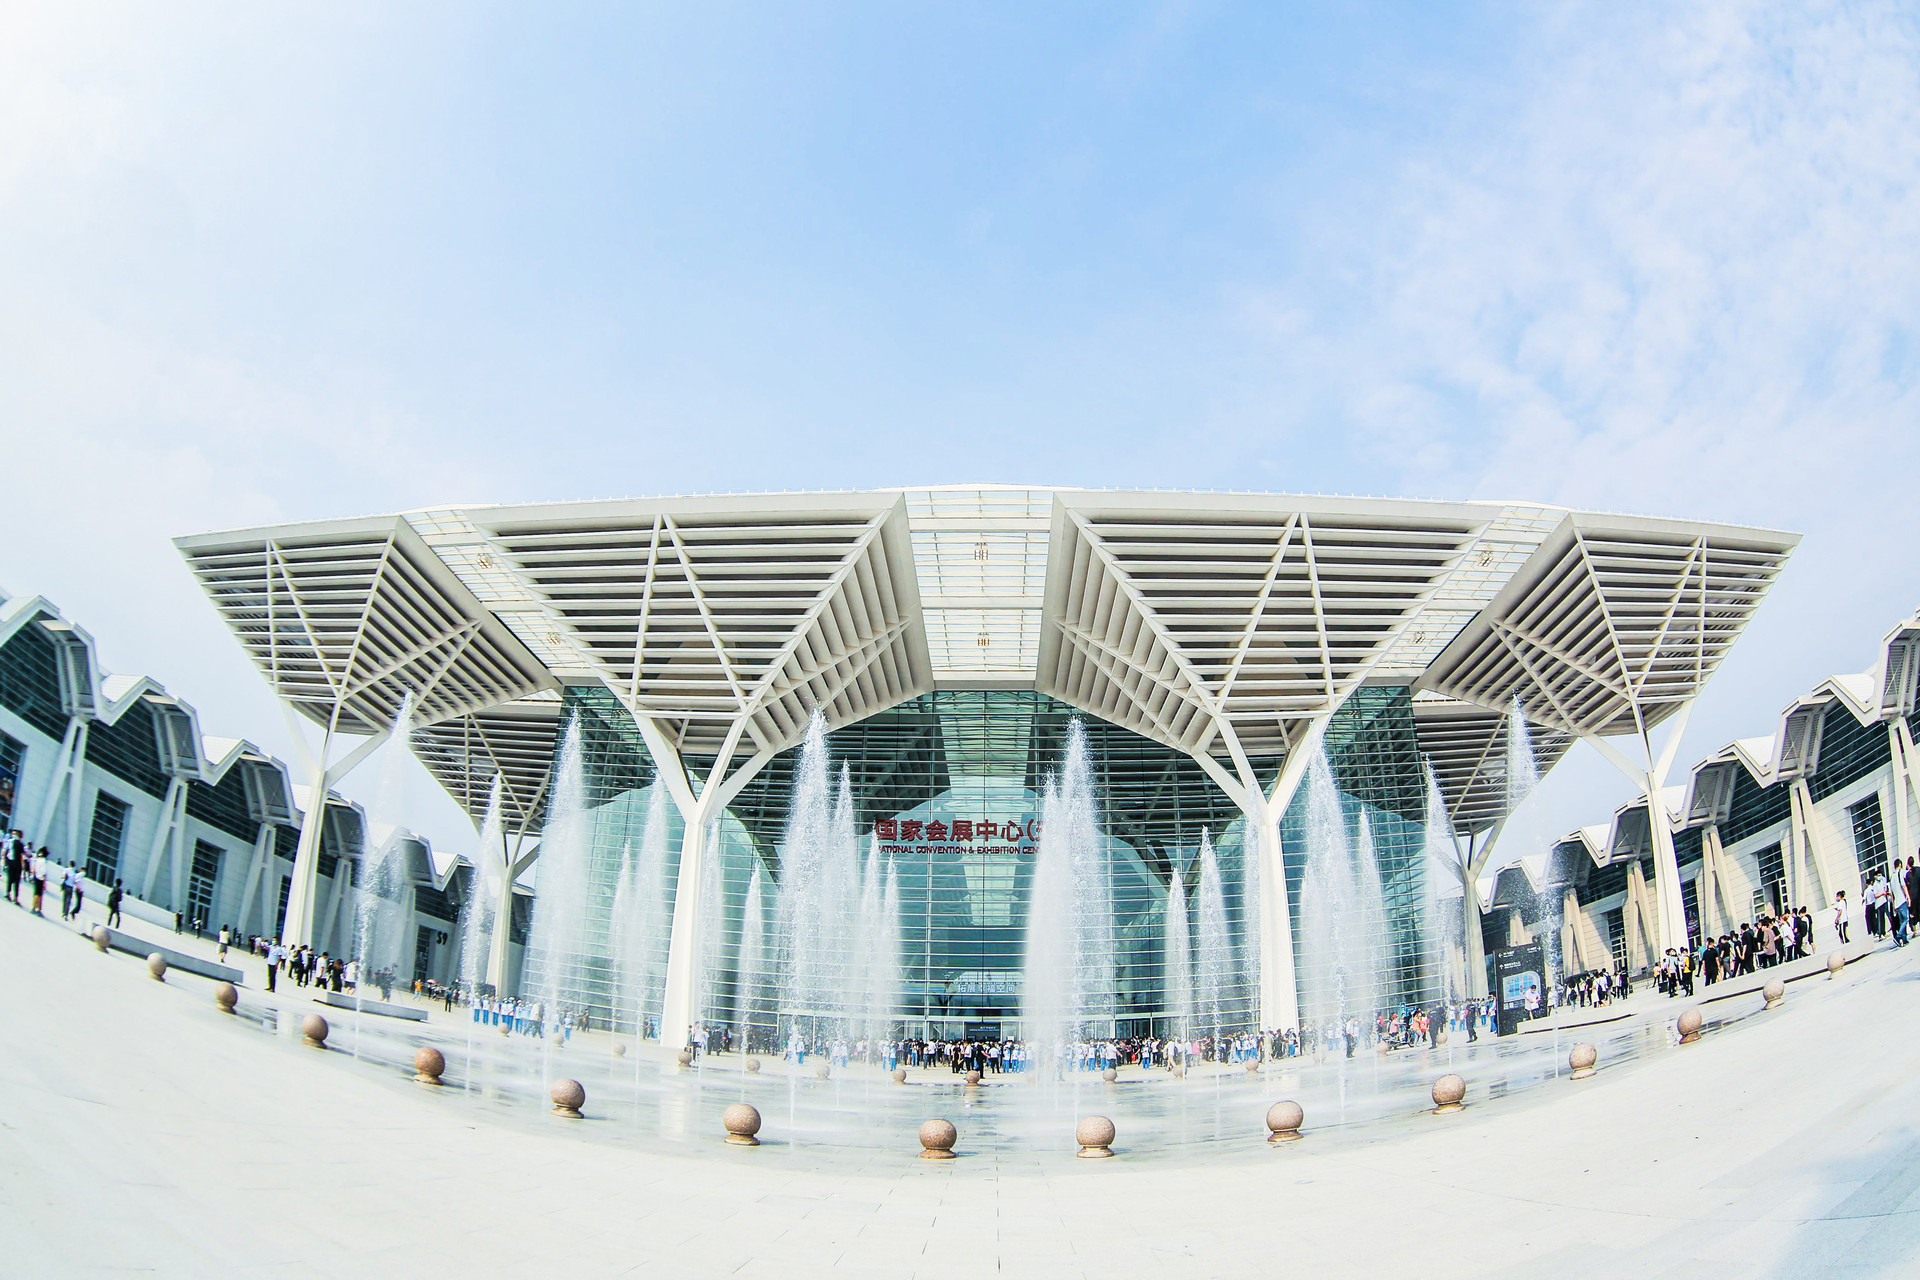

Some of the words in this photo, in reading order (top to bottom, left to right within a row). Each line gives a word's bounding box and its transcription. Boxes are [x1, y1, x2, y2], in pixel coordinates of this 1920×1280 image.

[916, 846, 967, 854] CONVENTION
[976, 846, 1020, 854] EXHIBITION
[437, 931, 448, 945] S9
